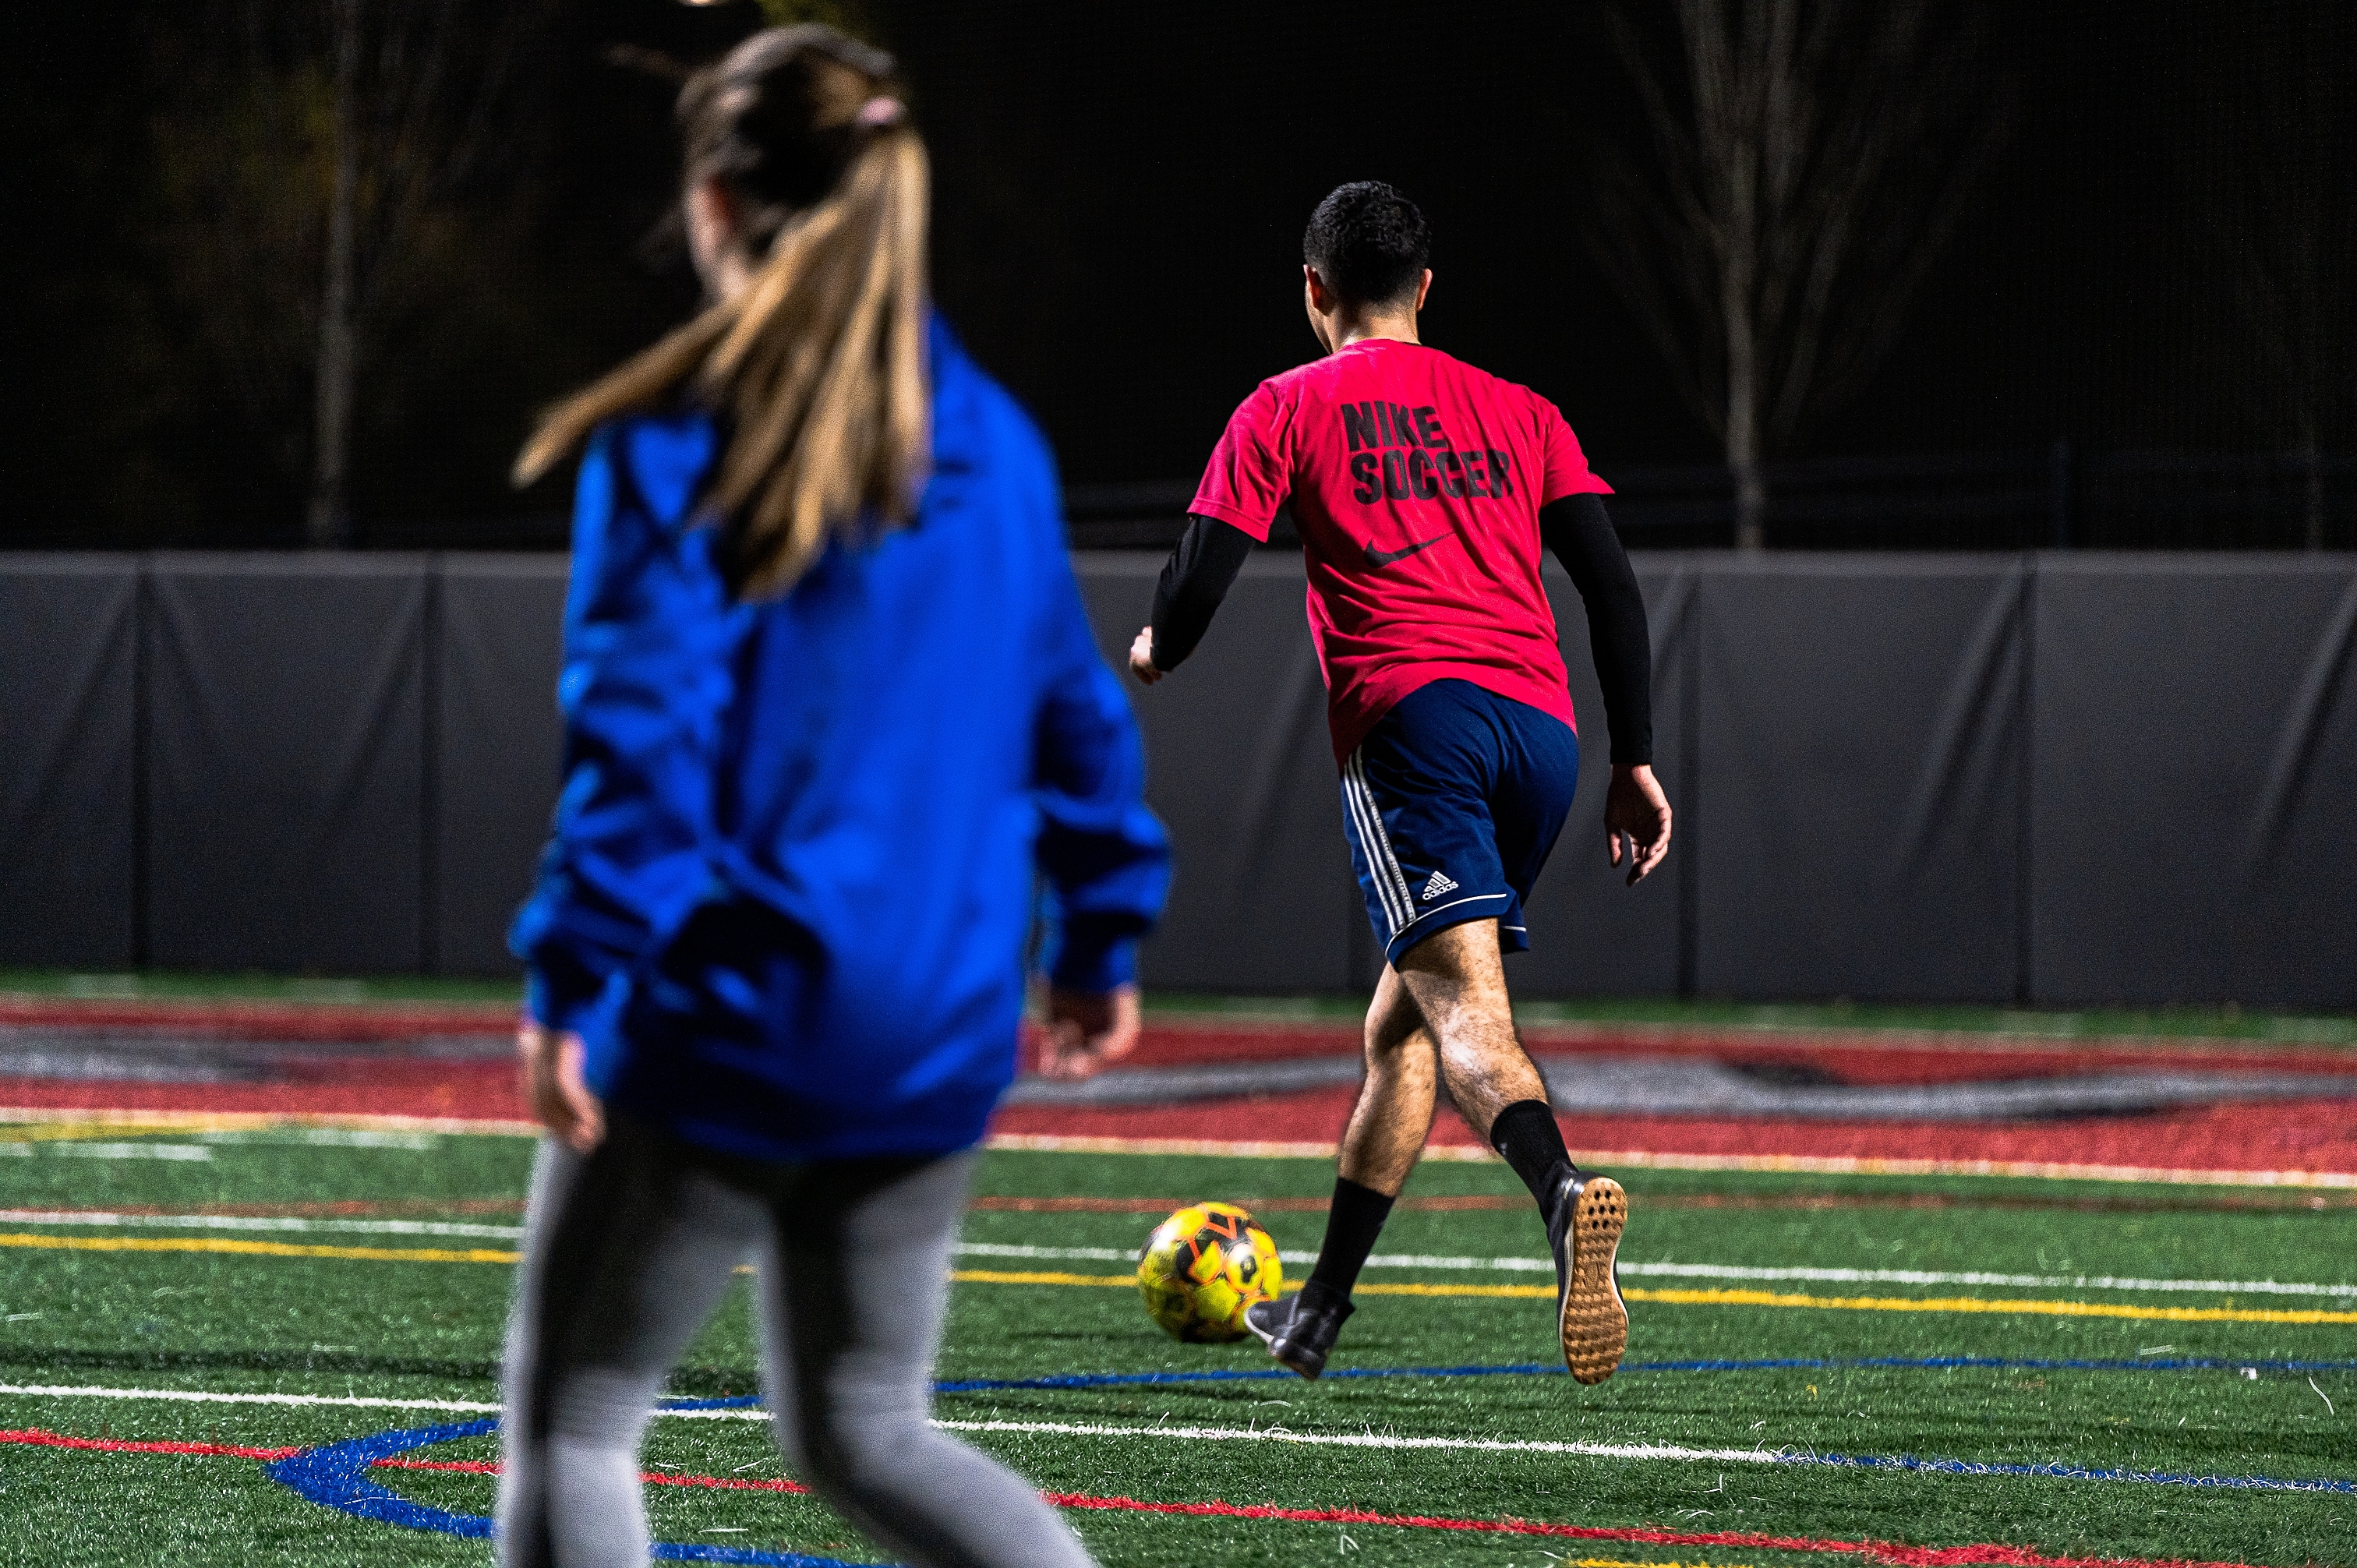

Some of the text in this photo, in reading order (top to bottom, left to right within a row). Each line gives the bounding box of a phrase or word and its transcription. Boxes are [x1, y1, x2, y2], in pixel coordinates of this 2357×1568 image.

[1341, 401, 1447, 452] NIKE
[1351, 448, 1514, 504] SOCCER
[1422, 881, 1459, 900] adidas
